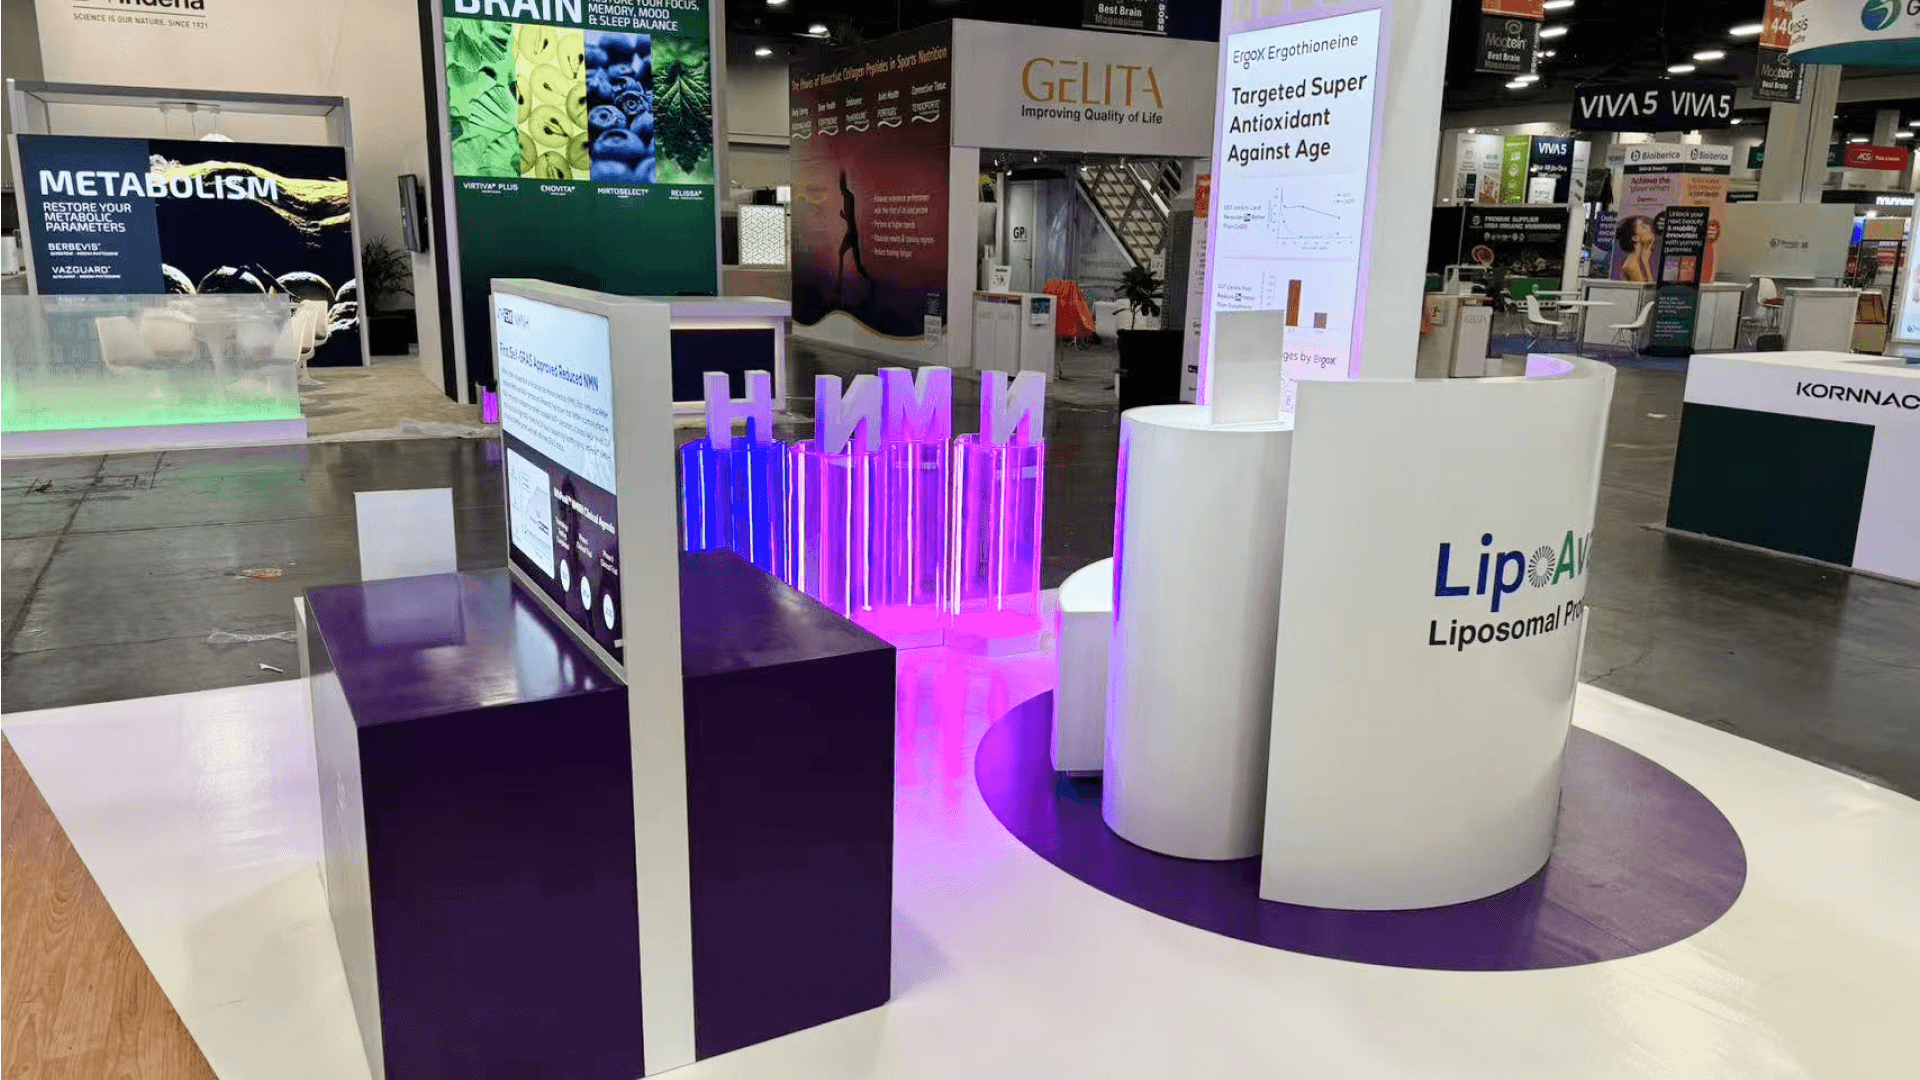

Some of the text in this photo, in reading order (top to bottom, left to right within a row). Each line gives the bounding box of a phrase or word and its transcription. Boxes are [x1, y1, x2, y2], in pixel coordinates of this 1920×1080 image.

[119, 0, 205, 9] ena
[588, 3, 670, 19] MEMORY, MOOD
[1098, 3, 1142, 17] Best Brain
[73, 13, 107, 22] SCIENCE
[588, 15, 678, 31] & SLEEP BALANCE
[1267, 34, 1358, 61] Ergothioneine
[1022, 57, 1163, 109] GELITA
[1232, 75, 1367, 107] Targeted Super
[1021, 104, 1163, 125] Improving Quality of Life
[1229, 108, 1331, 134] Antioxidant
[1227, 139, 1331, 166] Against Age
[1641, 149, 1680, 160] Bioiberica
[1699, 150, 1729, 161] Bioiberica
[39, 170, 279, 201] METABOLISM
[498, 183, 518, 191] PLUS
[43, 202, 132, 214] RESTORE YOUR
[44, 212, 113, 223] METABOLIC
[45, 222, 127, 233] PARAMETERS
[1300, 350, 1312, 365] by
[1796, 382, 1920, 410] KORNNAC
[1435, 530, 1593, 613] LipoAv
[1428, 596, 1585, 652] Liposomal Pro
